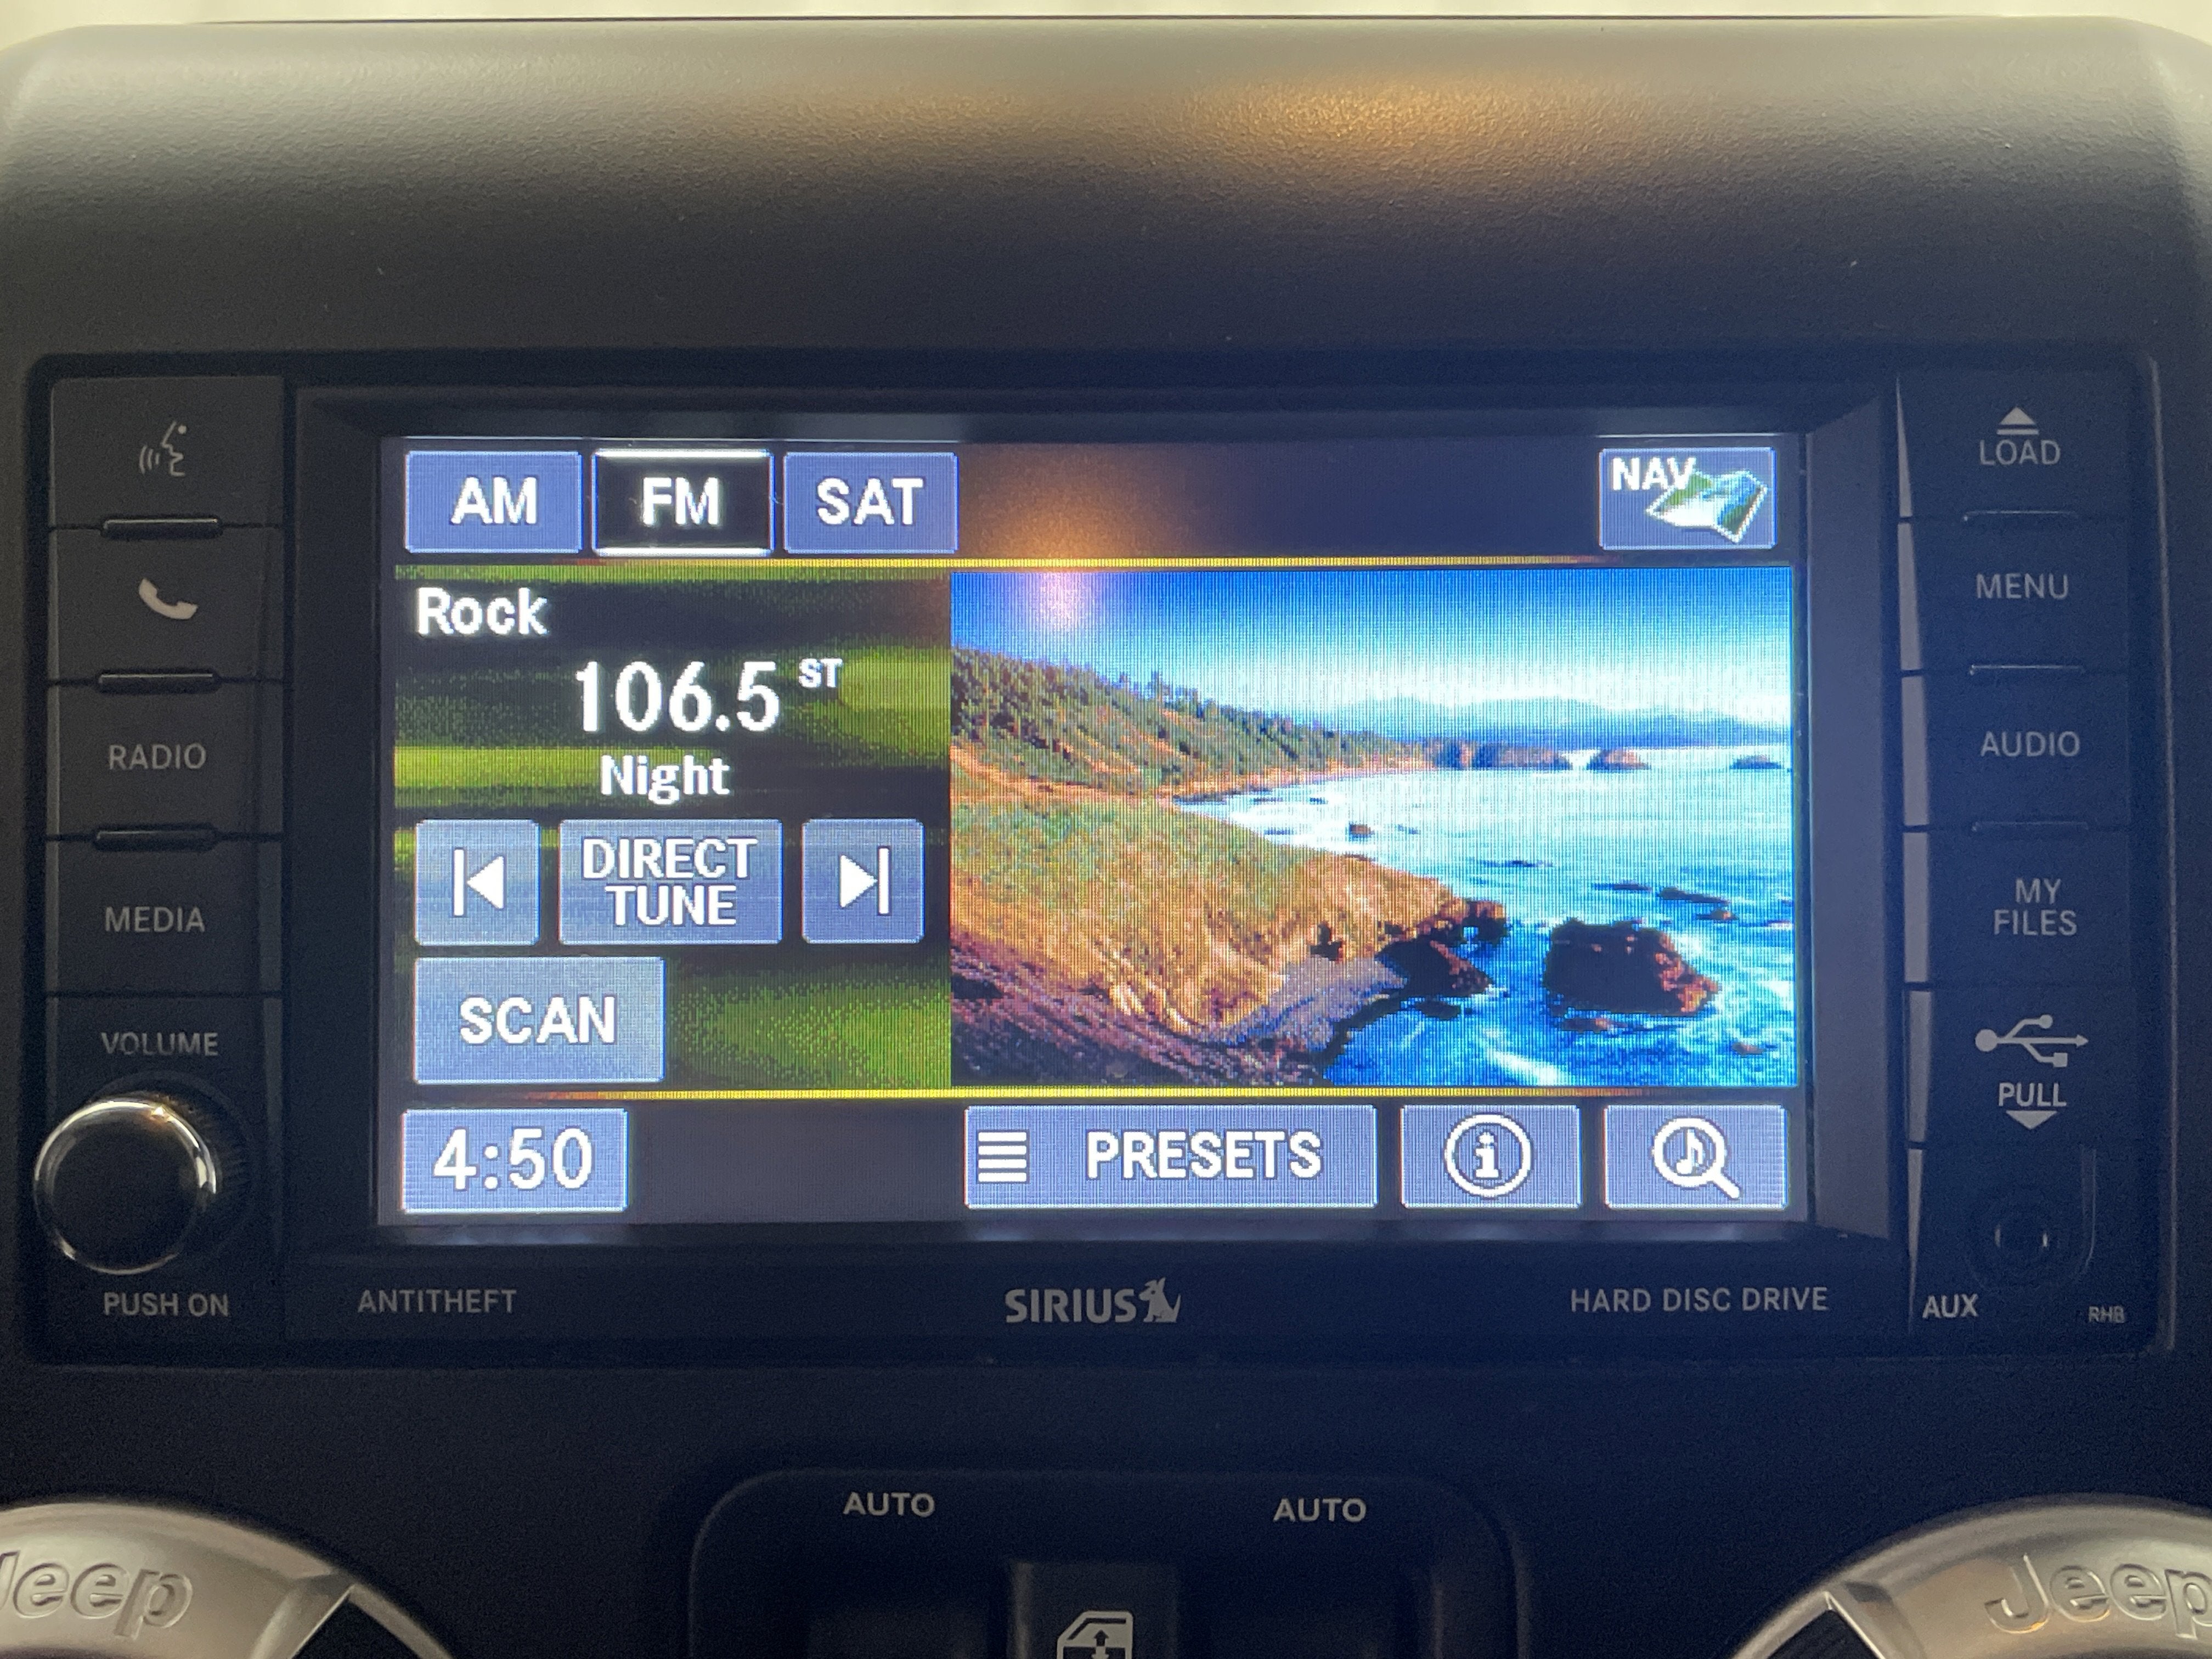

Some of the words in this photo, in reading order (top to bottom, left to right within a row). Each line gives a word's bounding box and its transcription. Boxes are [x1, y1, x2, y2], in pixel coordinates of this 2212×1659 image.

[1979, 439, 2061, 465] LOAD
[1611, 456, 1696, 490] NAV
[450, 476, 539, 526] AM
[641, 476, 721, 526] FM
[815, 477, 924, 526] SAT
[1975, 573, 2069, 600] MENU
[416, 587, 550, 636] Rock
[575, 660, 780, 733] 106.5
[798, 658, 843, 689] ST
[108, 742, 207, 770] RADIO
[1979, 731, 2081, 757] AUDIO
[600, 754, 731, 806] Night
[582, 837, 759, 879] DIRECT
[605, 884, 737, 927] TUNE
[2014, 878, 2061, 905] MY
[104, 905, 206, 933] MEDIA
[1993, 909, 2078, 936] FILES
[459, 996, 617, 1045] SCAN
[100, 1031, 219, 1057] VOLUME
[1998, 1082, 2067, 1108] PULL
[433, 1127, 594, 1192] 4:50
[1086, 1130, 1321, 1181] PRESETS
[103, 1291, 180, 1317] PUSH
[188, 1292, 230, 1317] ON
[357, 1288, 518, 1314] ANTITHEFT
[1004, 1288, 1138, 1324] SIRIUS
[1571, 1288, 1651, 1313] HARD
[1662, 1287, 1731, 1312] DISC
[1741, 1286, 1830, 1311] DRIVE
[1922, 1293, 1978, 1319] AUX
[842, 1491, 936, 1518] AUTO
[1272, 1497, 1368, 1523] AUTO
[1984, 1554, 2212, 1640] Jeep
